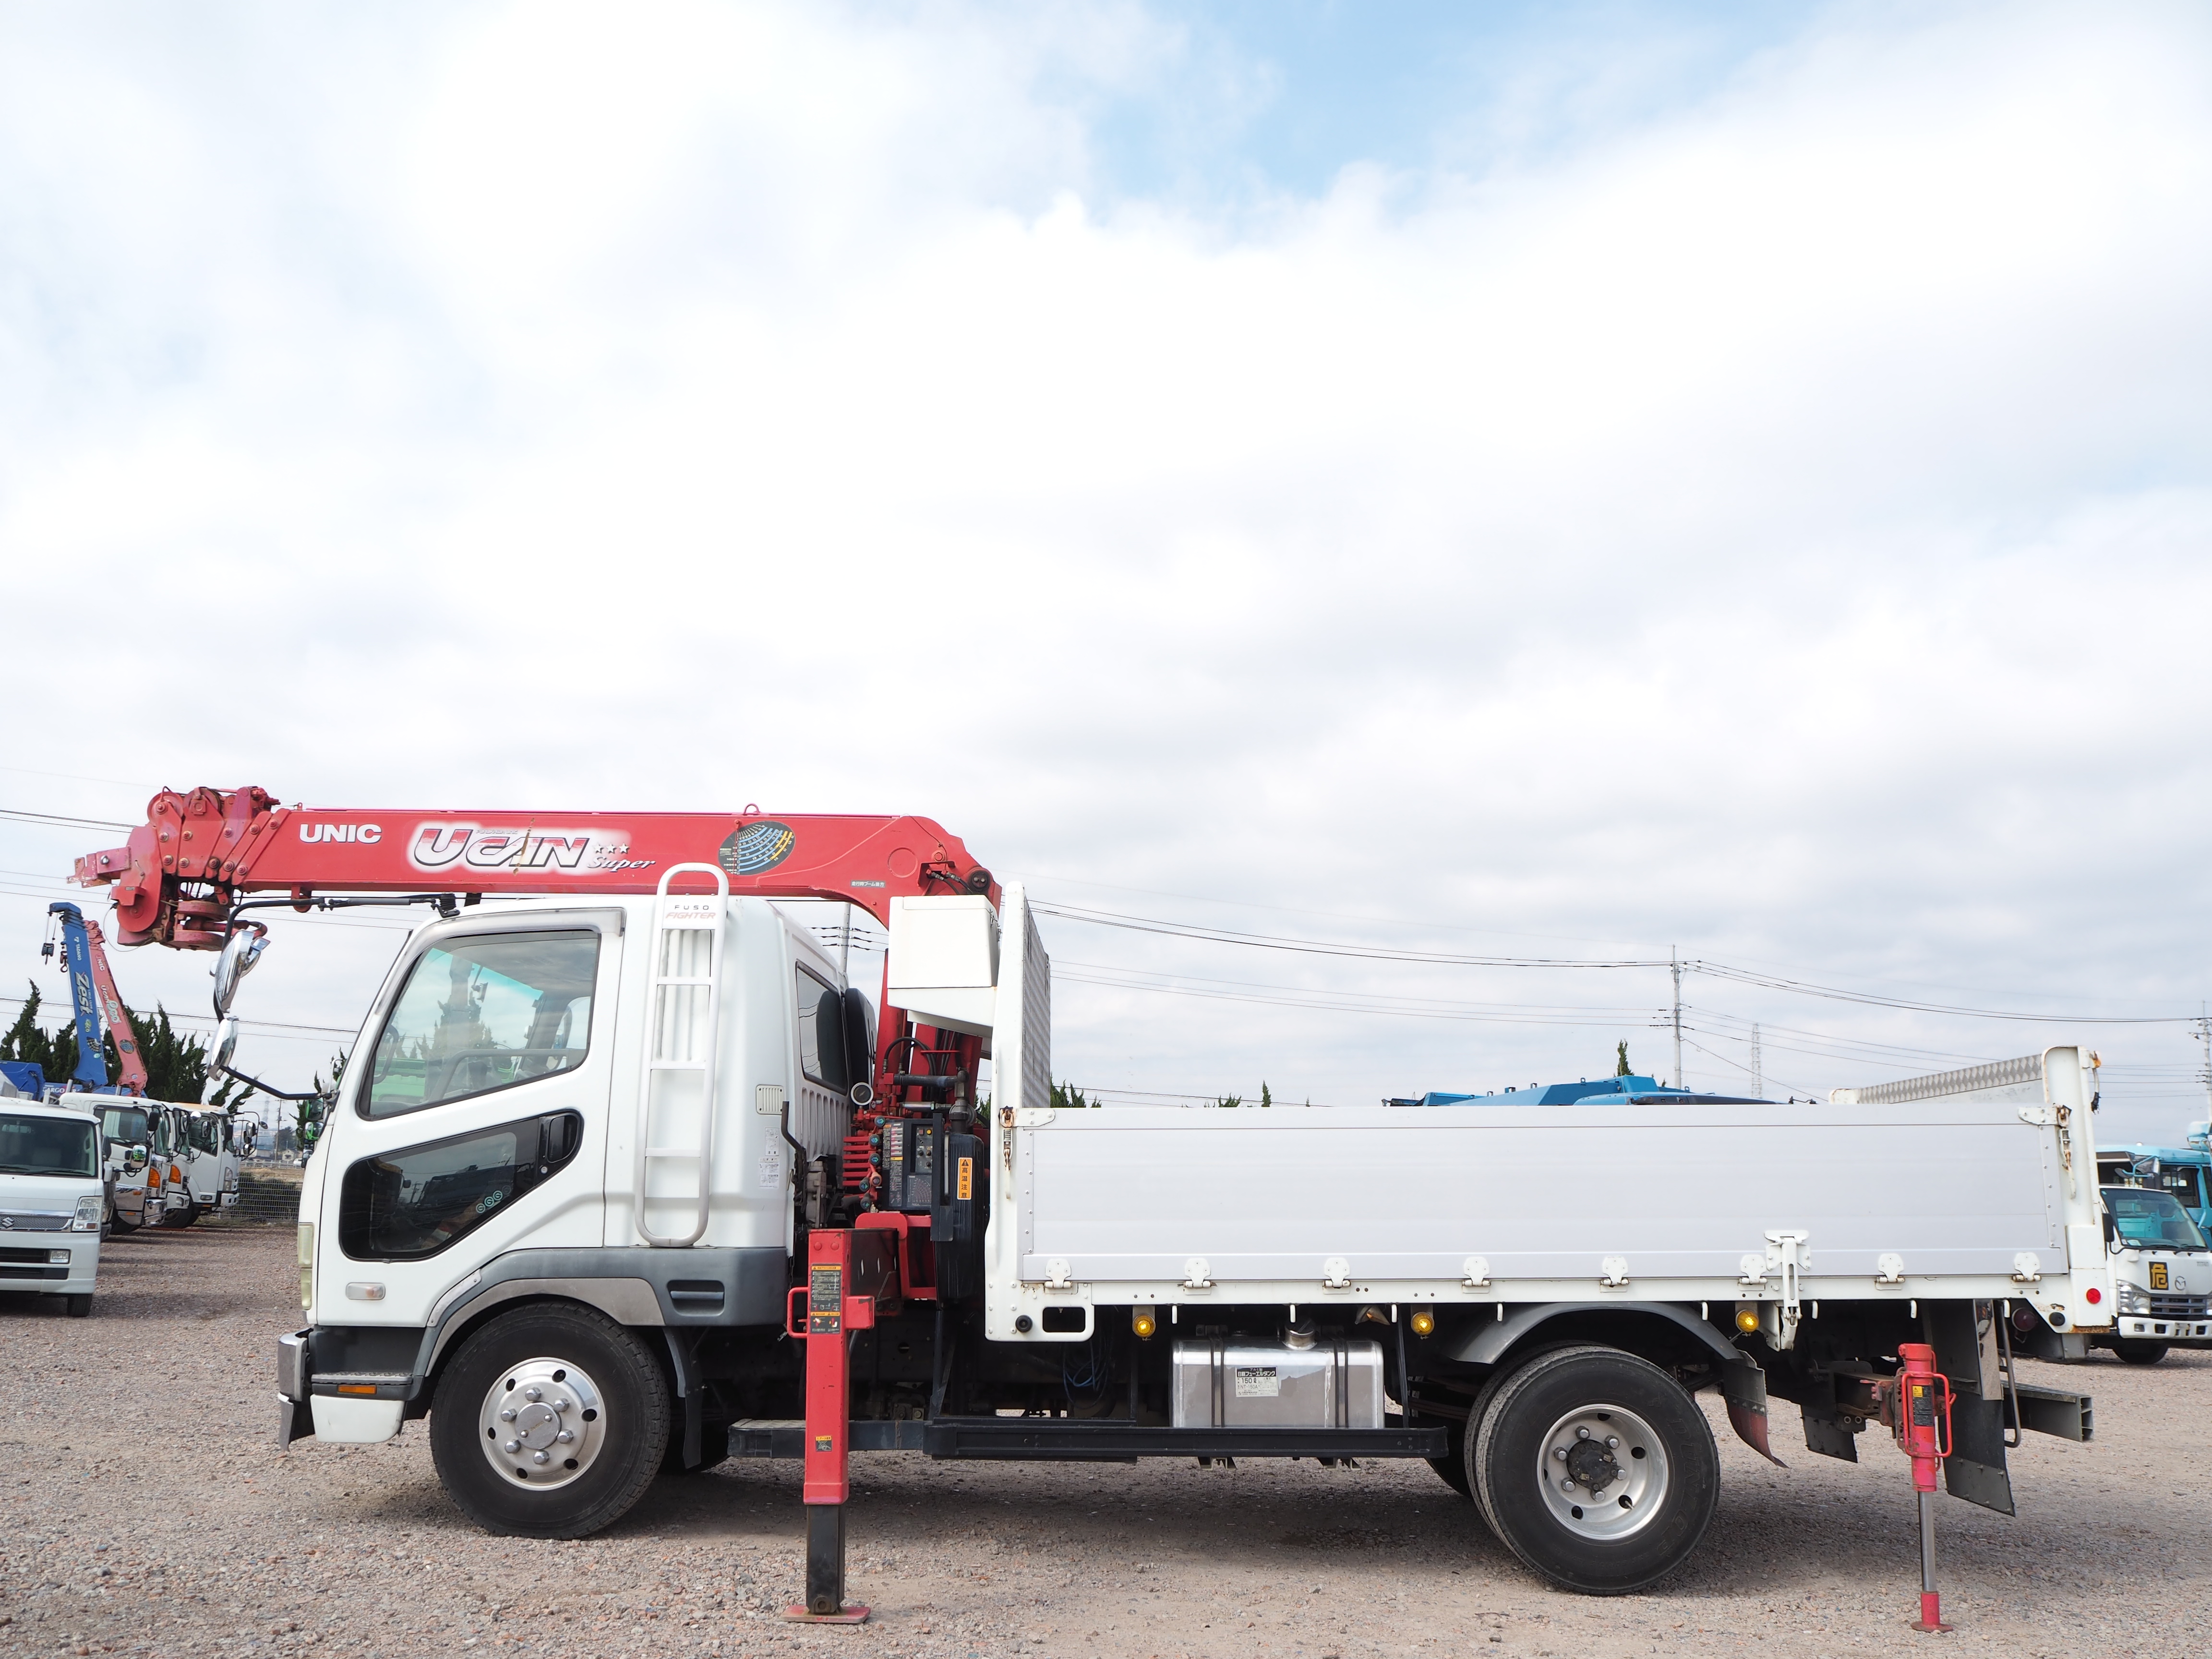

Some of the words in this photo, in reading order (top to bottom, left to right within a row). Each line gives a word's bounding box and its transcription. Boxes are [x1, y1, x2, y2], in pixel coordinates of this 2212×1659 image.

[299, 823, 382, 844] UNIC
[414, 828, 590, 868] UCAN
[587, 855, 656, 872] Super
[75, 971, 93, 1015] Zest
[2151, 1263, 2168, 1289] 危
